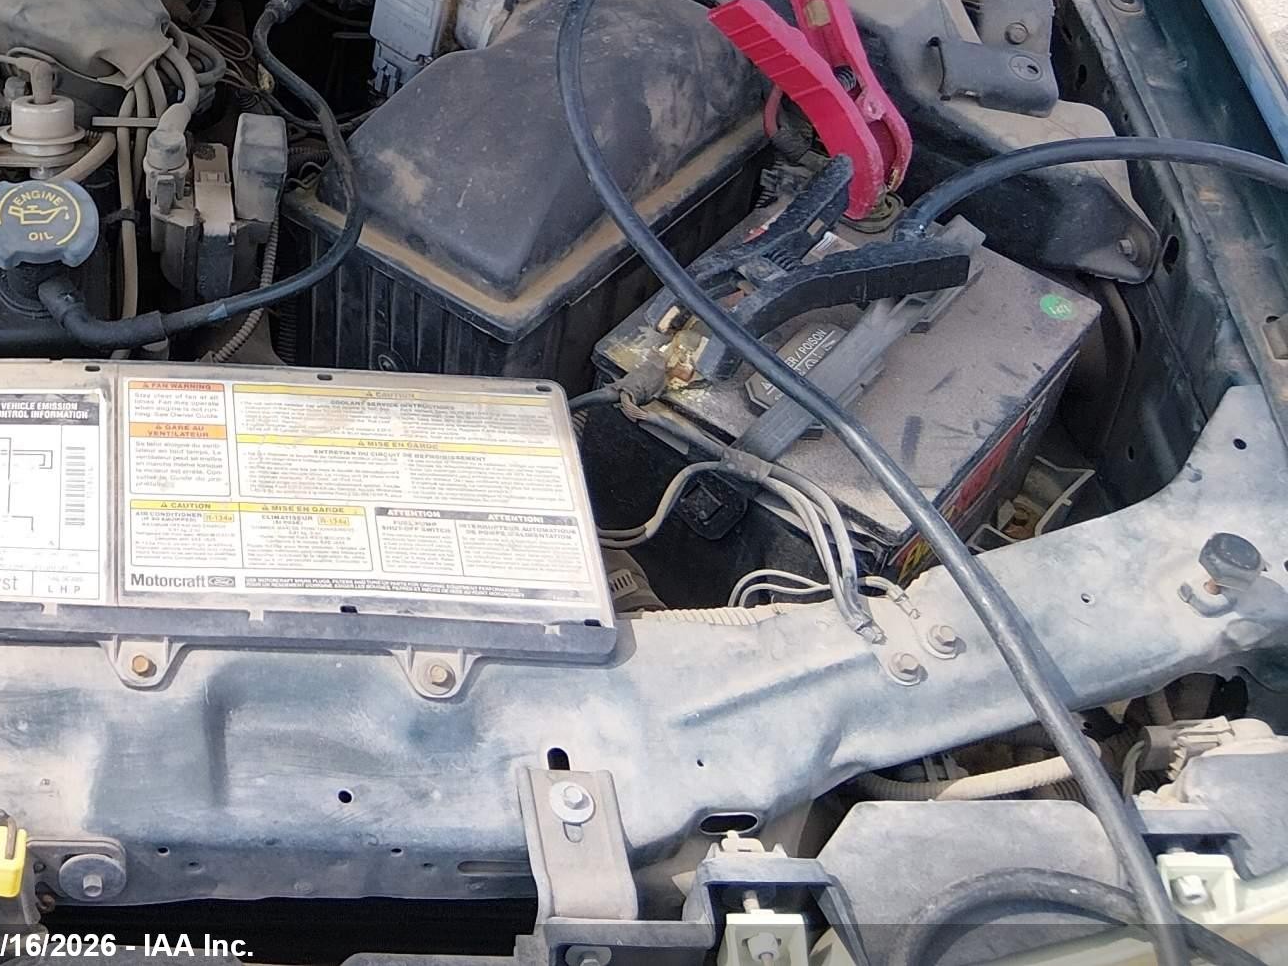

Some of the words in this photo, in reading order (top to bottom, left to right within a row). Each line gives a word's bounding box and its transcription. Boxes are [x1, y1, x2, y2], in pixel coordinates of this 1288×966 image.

[13, 191, 63, 206] ENGINE
[28, 232, 53, 242] OIL
[799, 328, 827, 355] POISON
[1, 402, 35, 411] VEHICLE
[37, 403, 78, 411] EMISSION
[31, 410, 88, 420] INFORMATION
[387, 509, 441, 518] ATTENTION
[487, 514, 544, 523] ATTENTION!
[131, 573, 205, 587] Motorcraft
